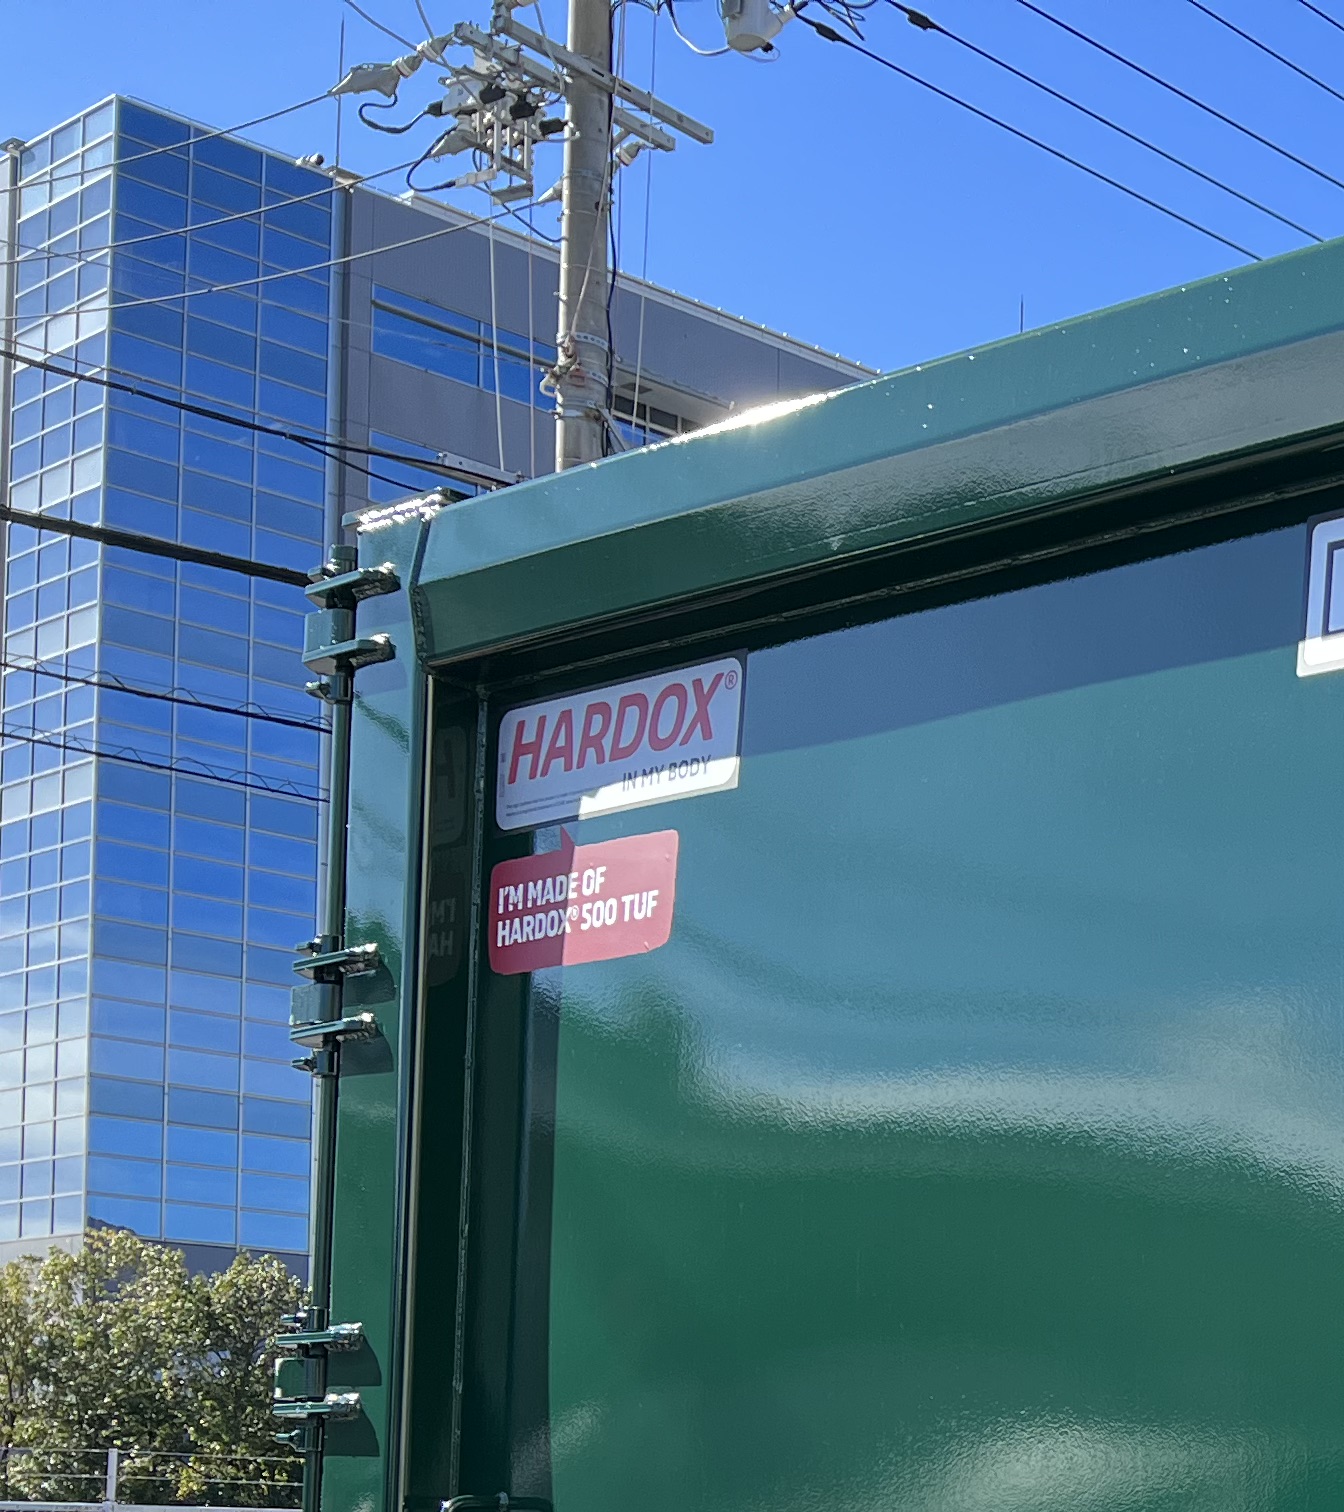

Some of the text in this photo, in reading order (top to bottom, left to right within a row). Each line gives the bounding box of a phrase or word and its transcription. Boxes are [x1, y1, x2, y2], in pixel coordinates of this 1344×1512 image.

[621, 754, 713, 792] IN MY BODY
[526, 871, 580, 909] MADE
[581, 865, 608, 897] OF
[580, 897, 618, 931] 500
[621, 889, 660, 922] TUF
